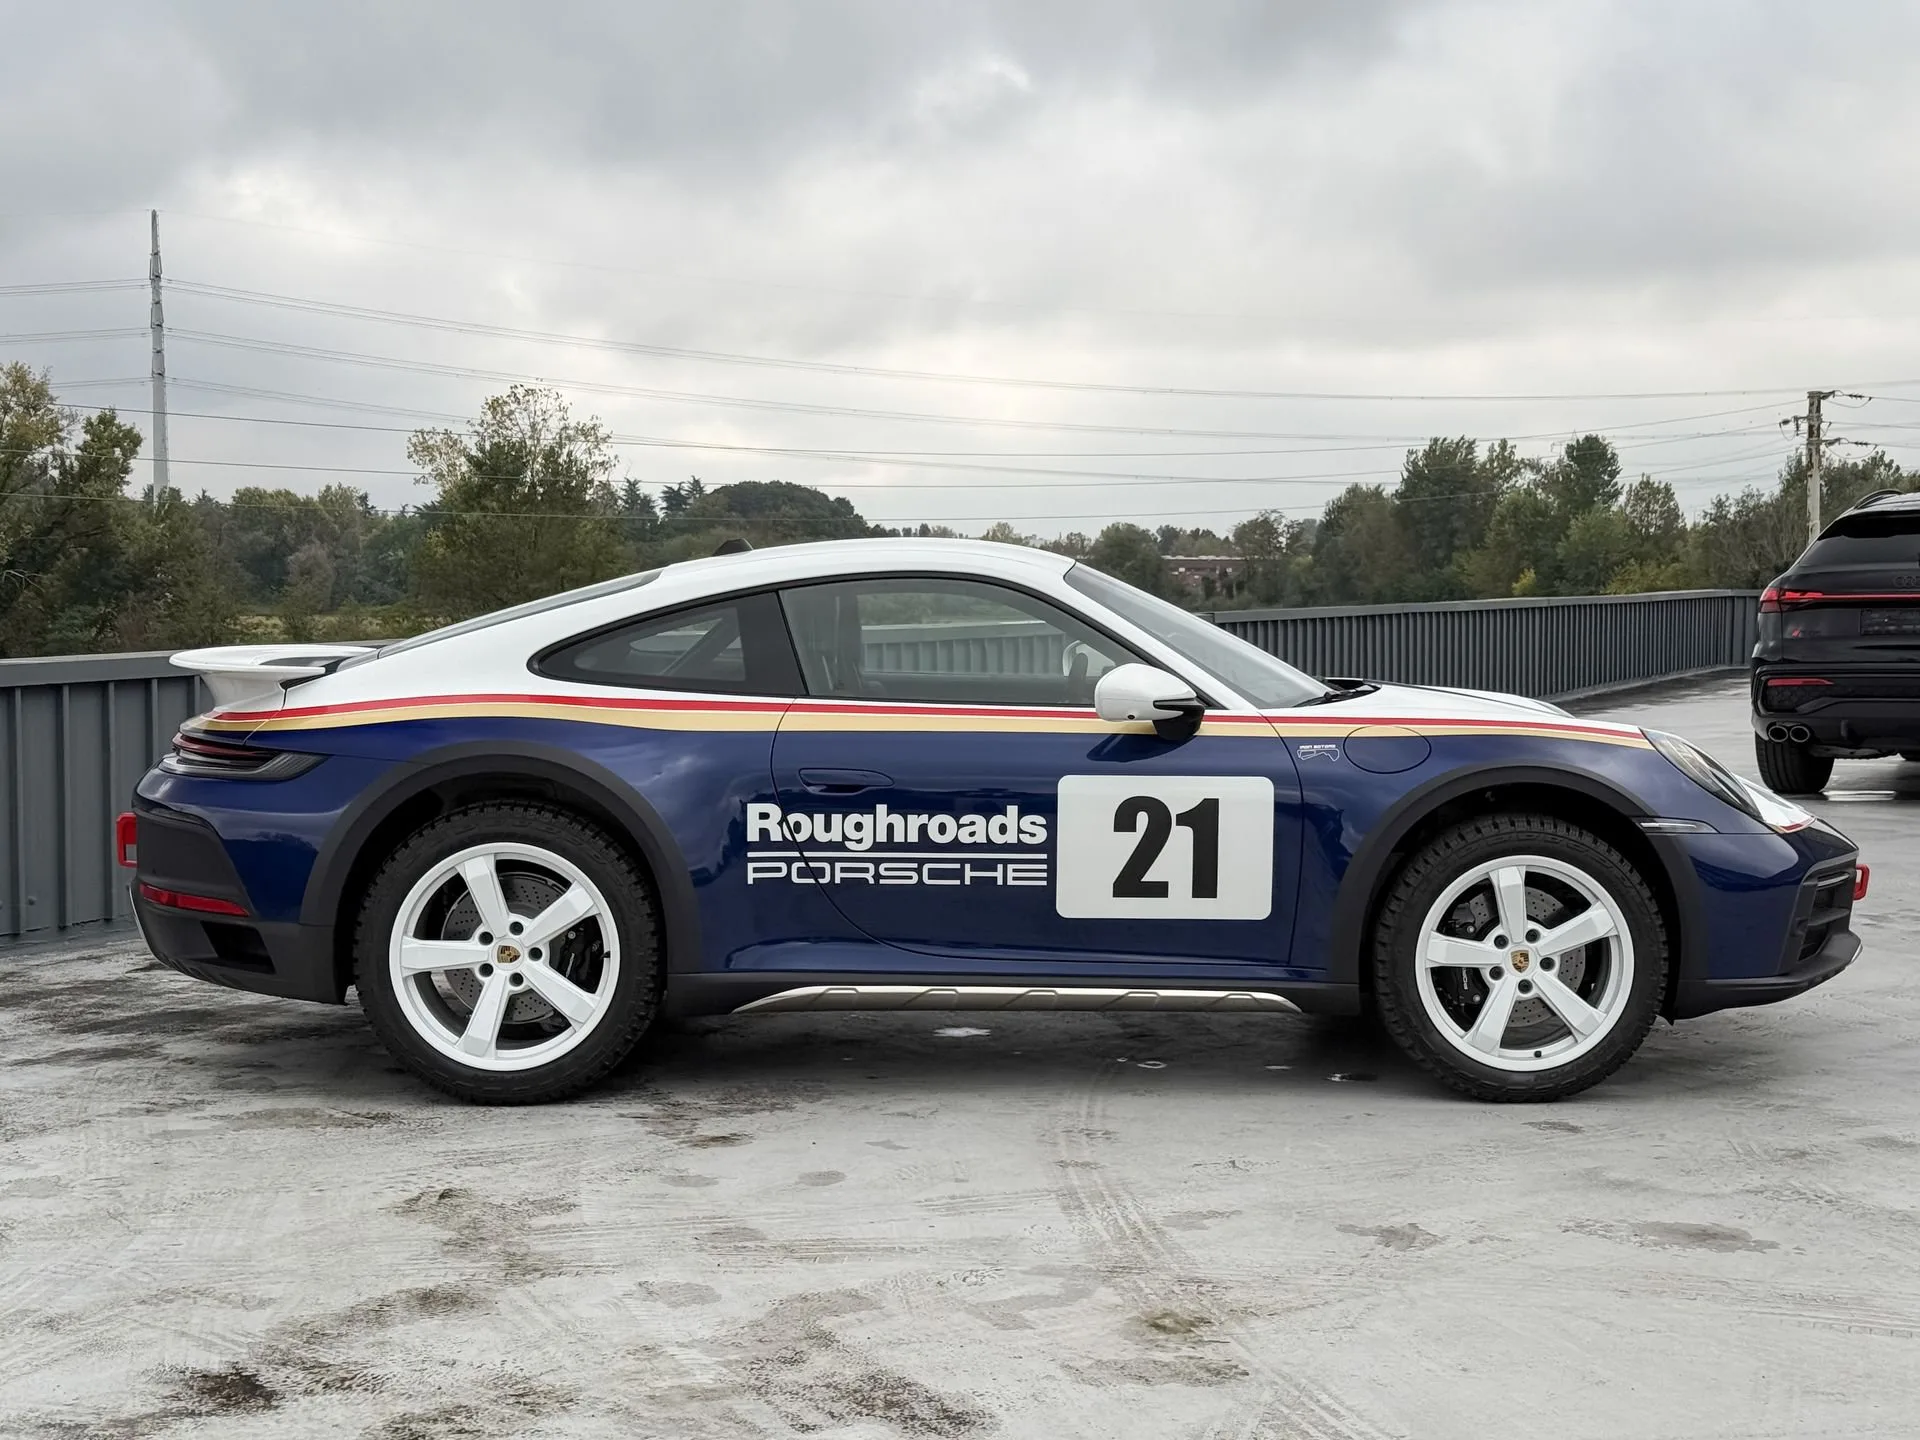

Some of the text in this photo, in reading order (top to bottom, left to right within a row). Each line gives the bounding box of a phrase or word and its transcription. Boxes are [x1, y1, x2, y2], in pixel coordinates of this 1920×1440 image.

[747, 803, 1048, 850] Roughroads
[1112, 795, 1219, 899] 21
[747, 862, 1048, 886] PORSCHE
